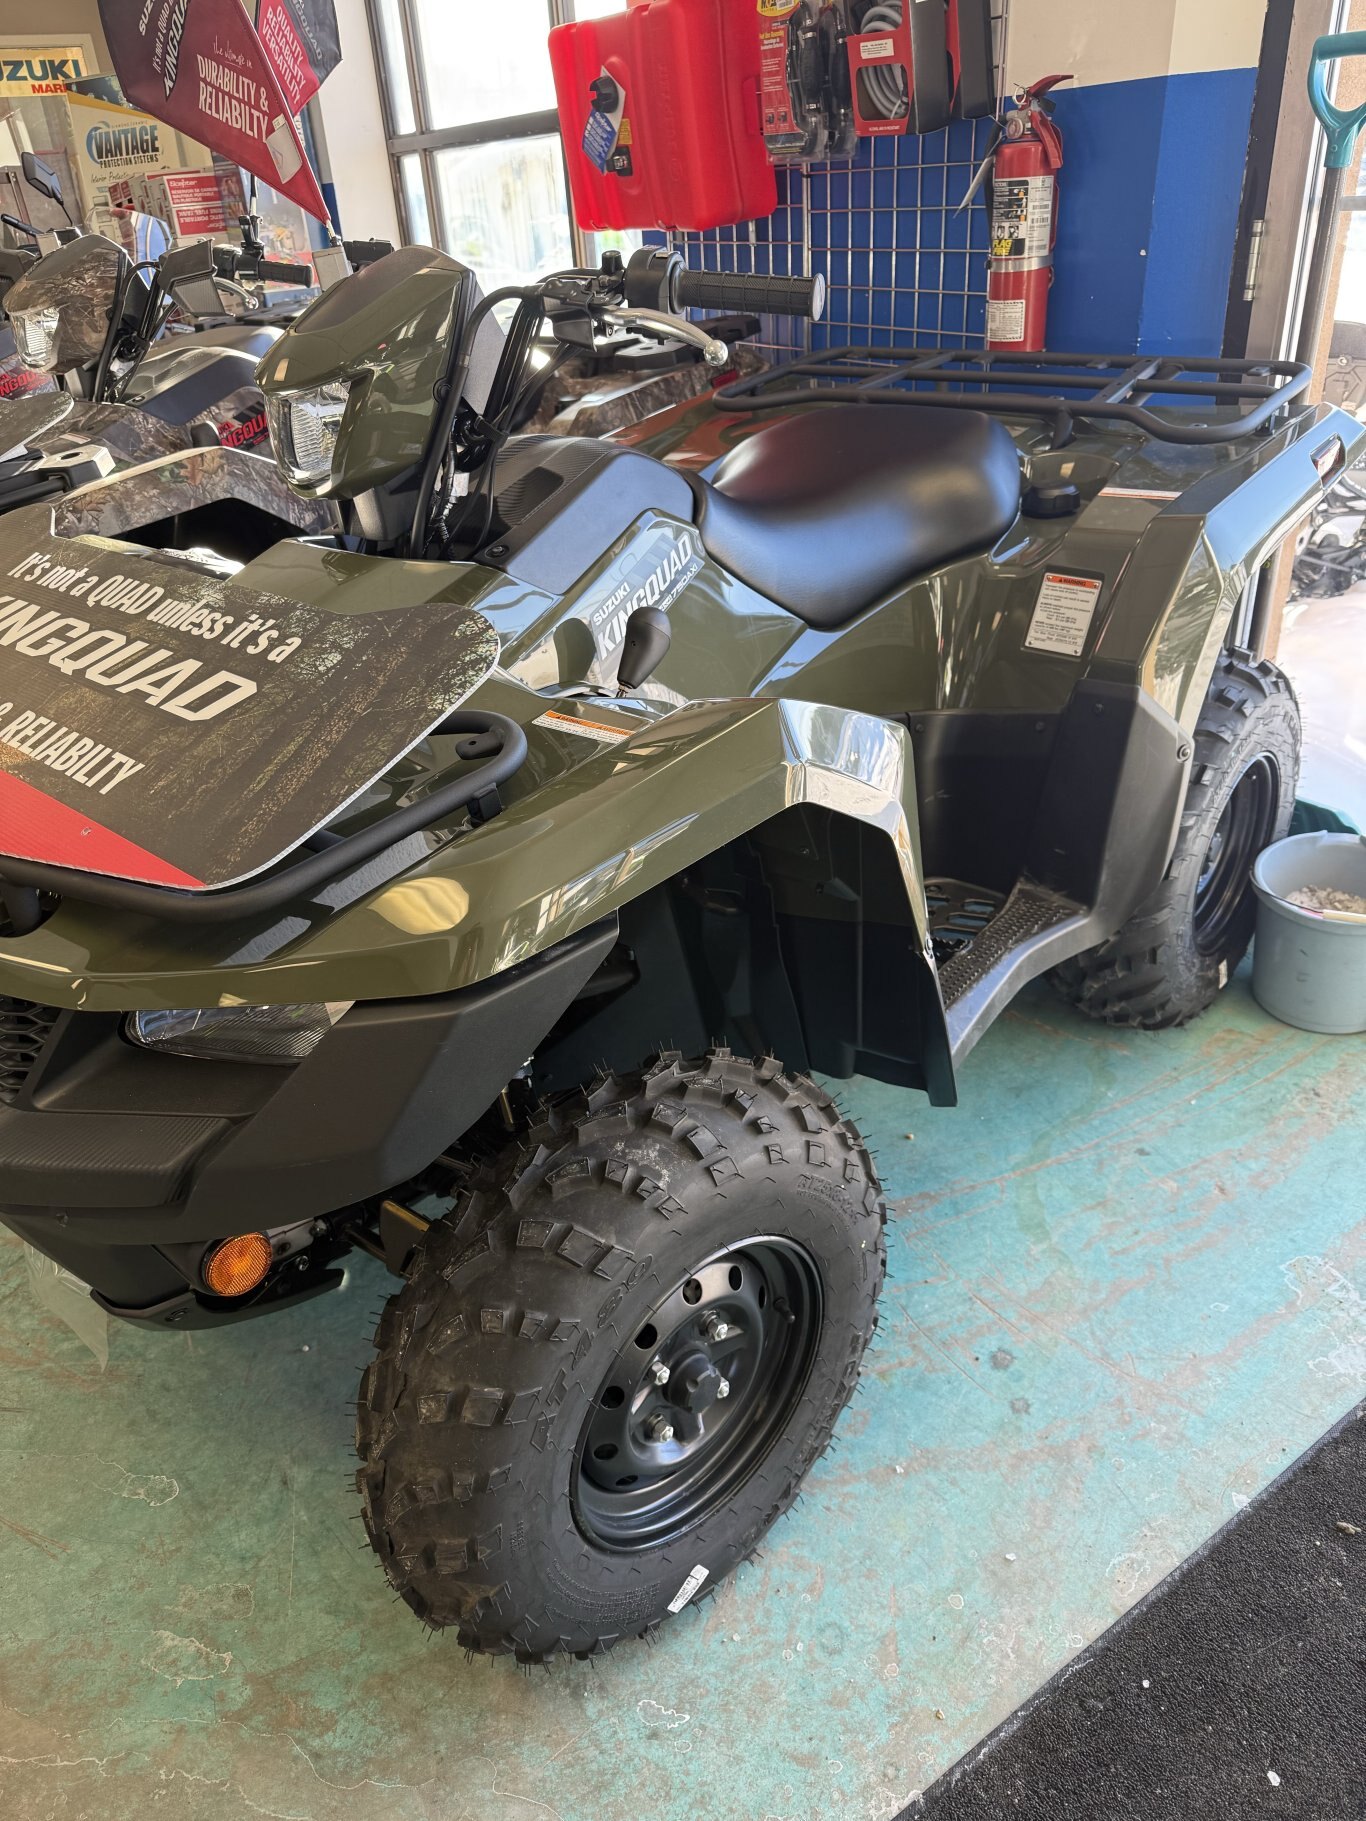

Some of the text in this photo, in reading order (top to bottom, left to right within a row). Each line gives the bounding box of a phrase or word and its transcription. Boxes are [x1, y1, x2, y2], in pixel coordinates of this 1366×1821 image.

[139, 0, 155, 36] SUZ
[158, 2, 170, 34] QUAD
[276, 5, 304, 66] QUALITY
[155, 38, 163, 58] not
[158, 32, 164, 42] a
[266, 5, 307, 90] RELIABILITY
[0, 59, 82, 81] ZUKI
[262, 18, 301, 105] VERSATILITY
[196, 53, 270, 114] DURABILITY &
[94, 125, 160, 160] VANTAGE
[99, 154, 159, 169] PROTECTION SYSTEMS
[993, 239, 1013, 248] FLAG
[7, 551, 302, 664] It's not a QUAD unless it's a
[592, 580, 632, 627] SUZUKI
